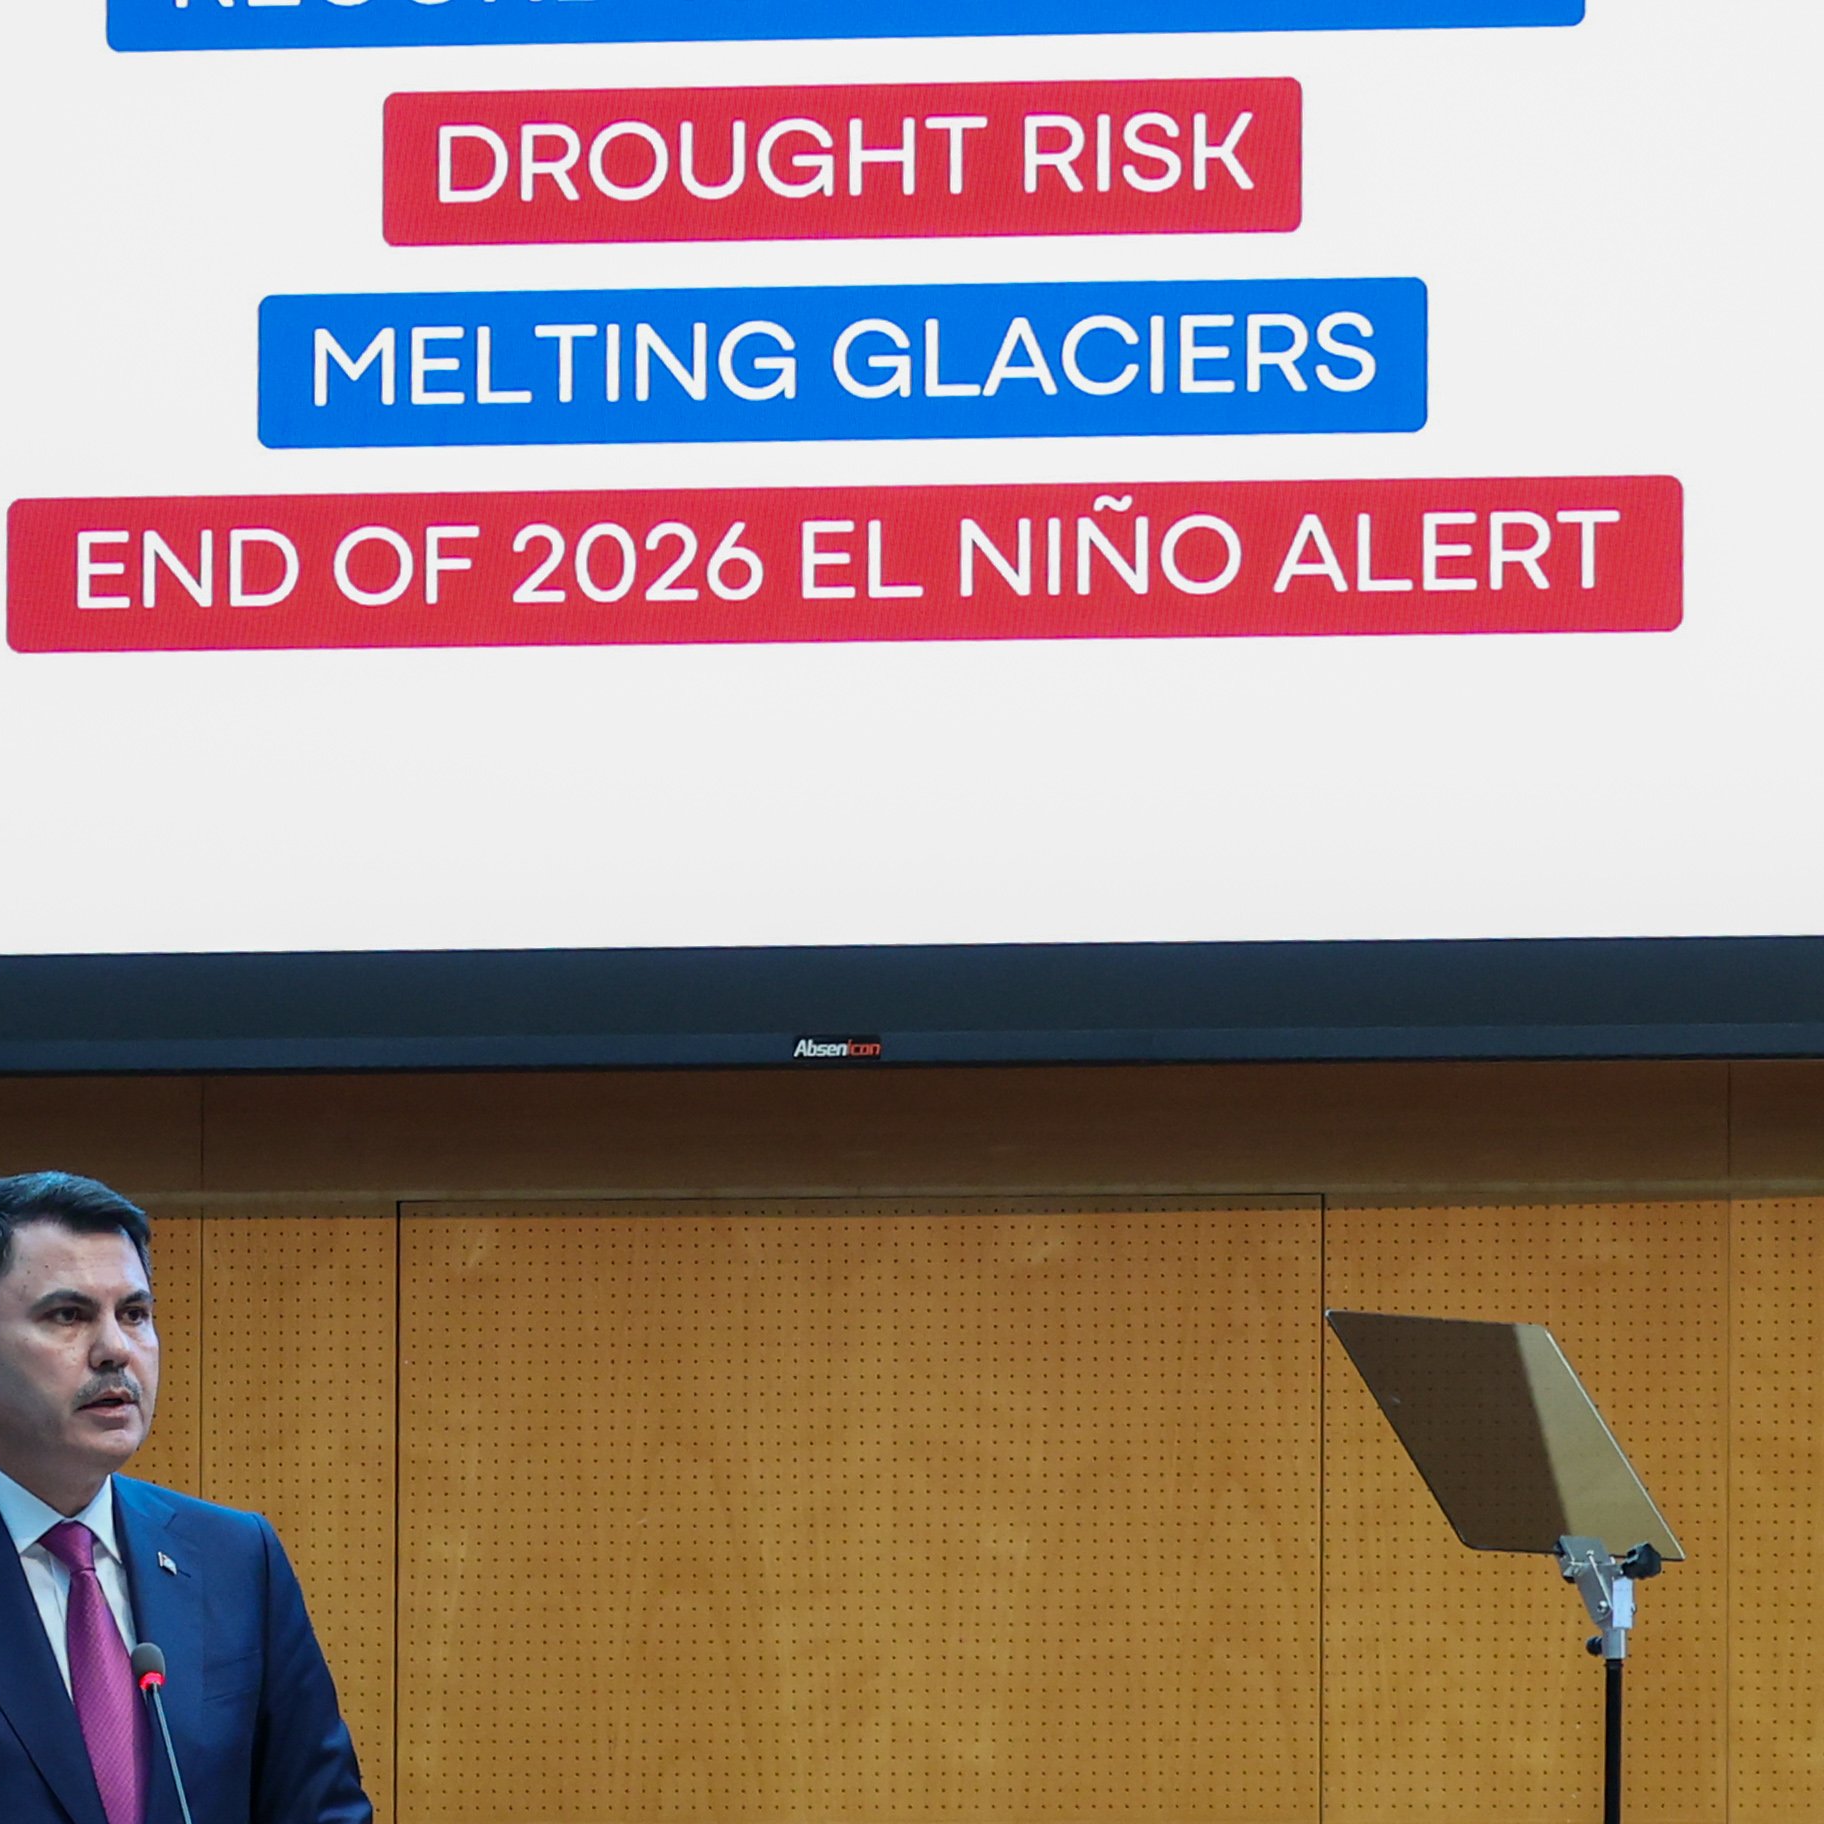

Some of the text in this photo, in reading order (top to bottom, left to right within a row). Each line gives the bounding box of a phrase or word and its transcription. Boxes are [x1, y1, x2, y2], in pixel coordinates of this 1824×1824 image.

[438, 112, 1255, 204] DROUGHT RISK
[314, 311, 1376, 407] MELTING GLACIERS
[77, 495, 1621, 609] END OF 2026 EL NIÑO ALERT
